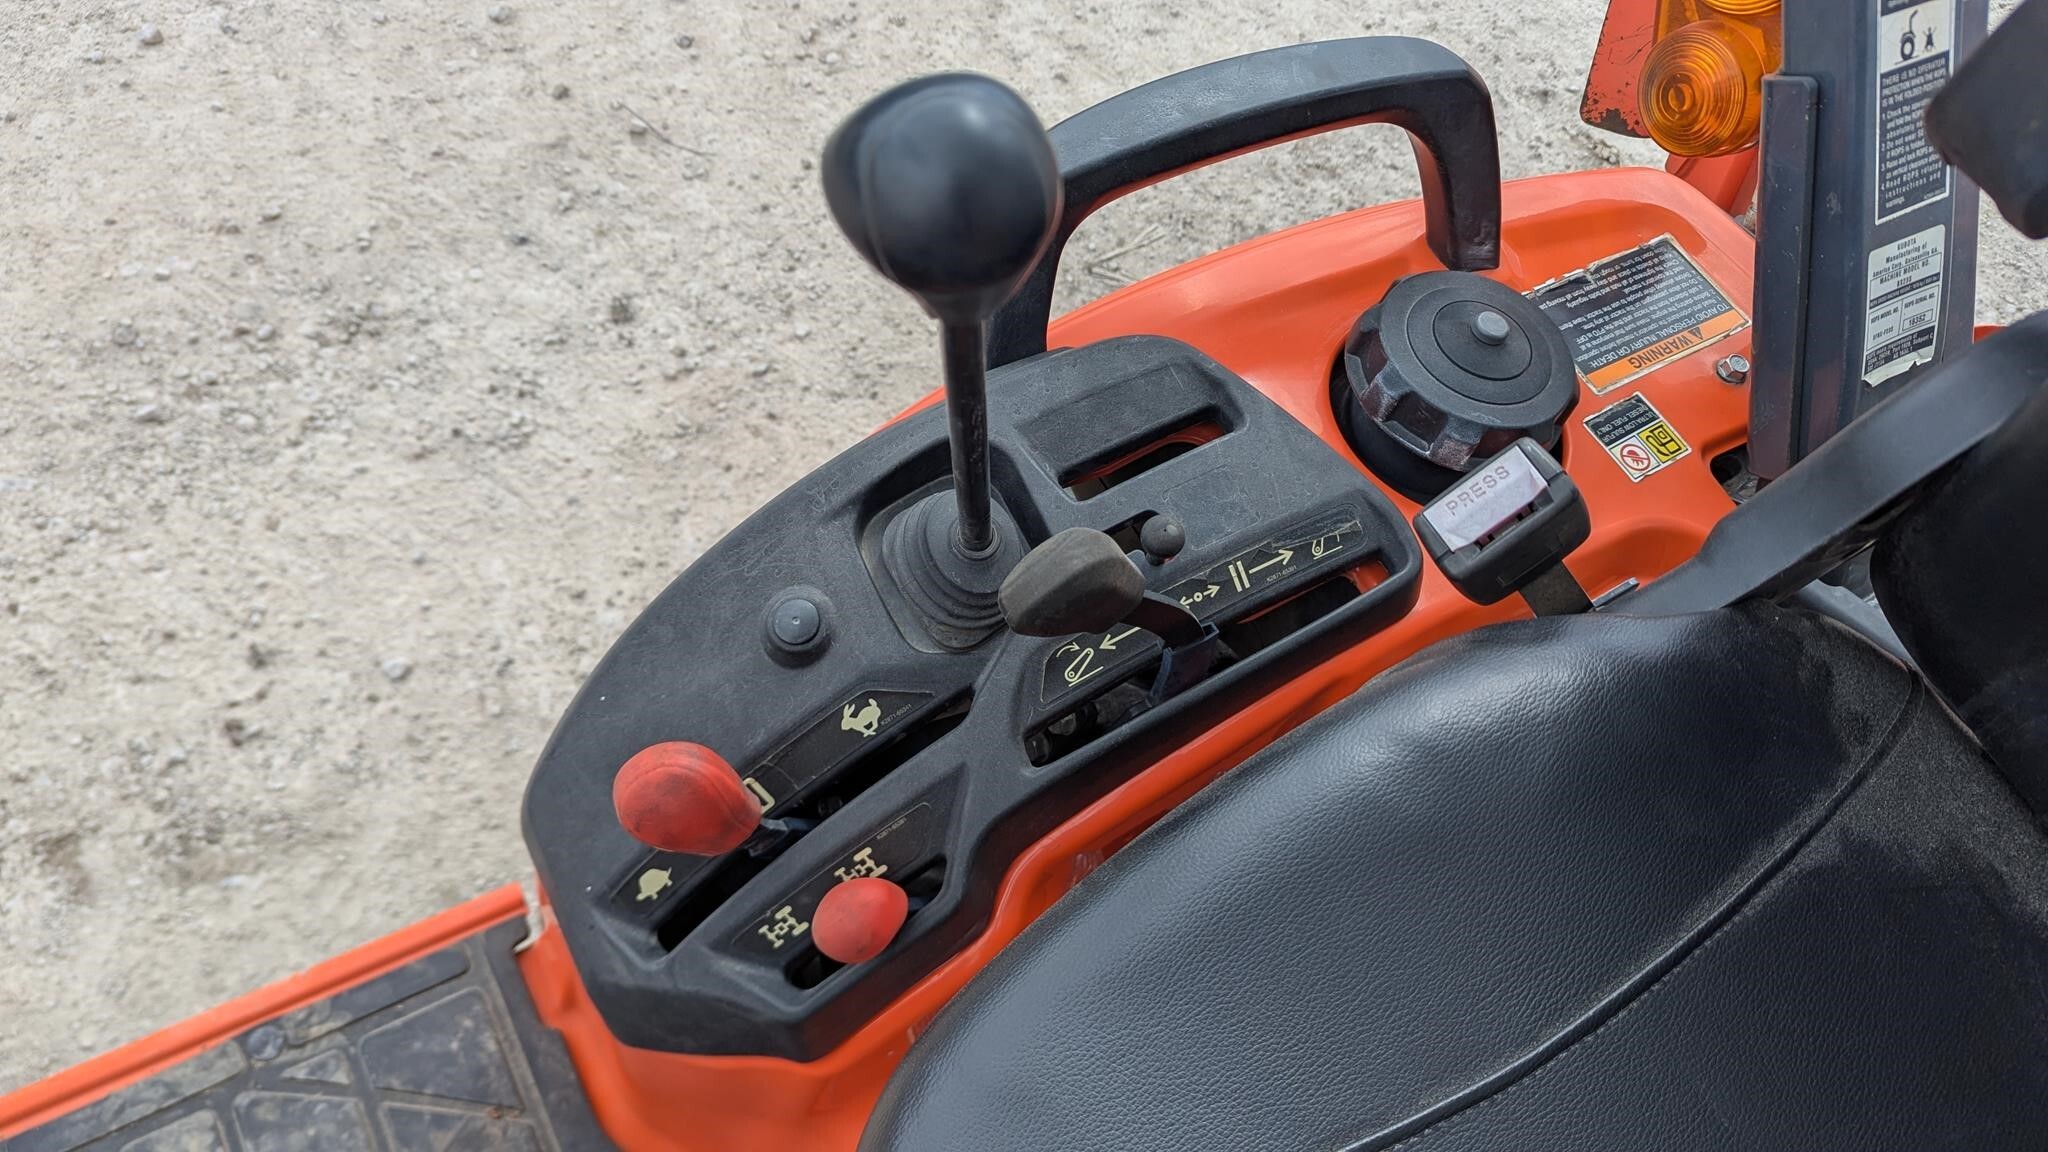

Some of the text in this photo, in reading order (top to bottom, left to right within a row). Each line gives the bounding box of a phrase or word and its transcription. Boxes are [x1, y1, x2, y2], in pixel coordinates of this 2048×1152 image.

[1918, 57, 1945, 73] OPERATOR
[1883, 80, 1910, 96] PROTECTION
[1921, 161, 1942, 175] related
[1886, 177, 1926, 199] instructions
[1886, 245, 1920, 263] Manufacturing
[1880, 270, 1901, 284] MACHINE
[1656, 317, 1696, 338] PERSONAL
[1627, 334, 1692, 368] WARNING
[1629, 334, 1657, 350] INJURY
[1588, 352, 1618, 368] DEATH:
[1596, 405, 1648, 435] DIESEL FUEL ONLY
[1601, 412, 1656, 442] ULTRA LOW SULFUR
[1446, 465, 1510, 516] PRESS
